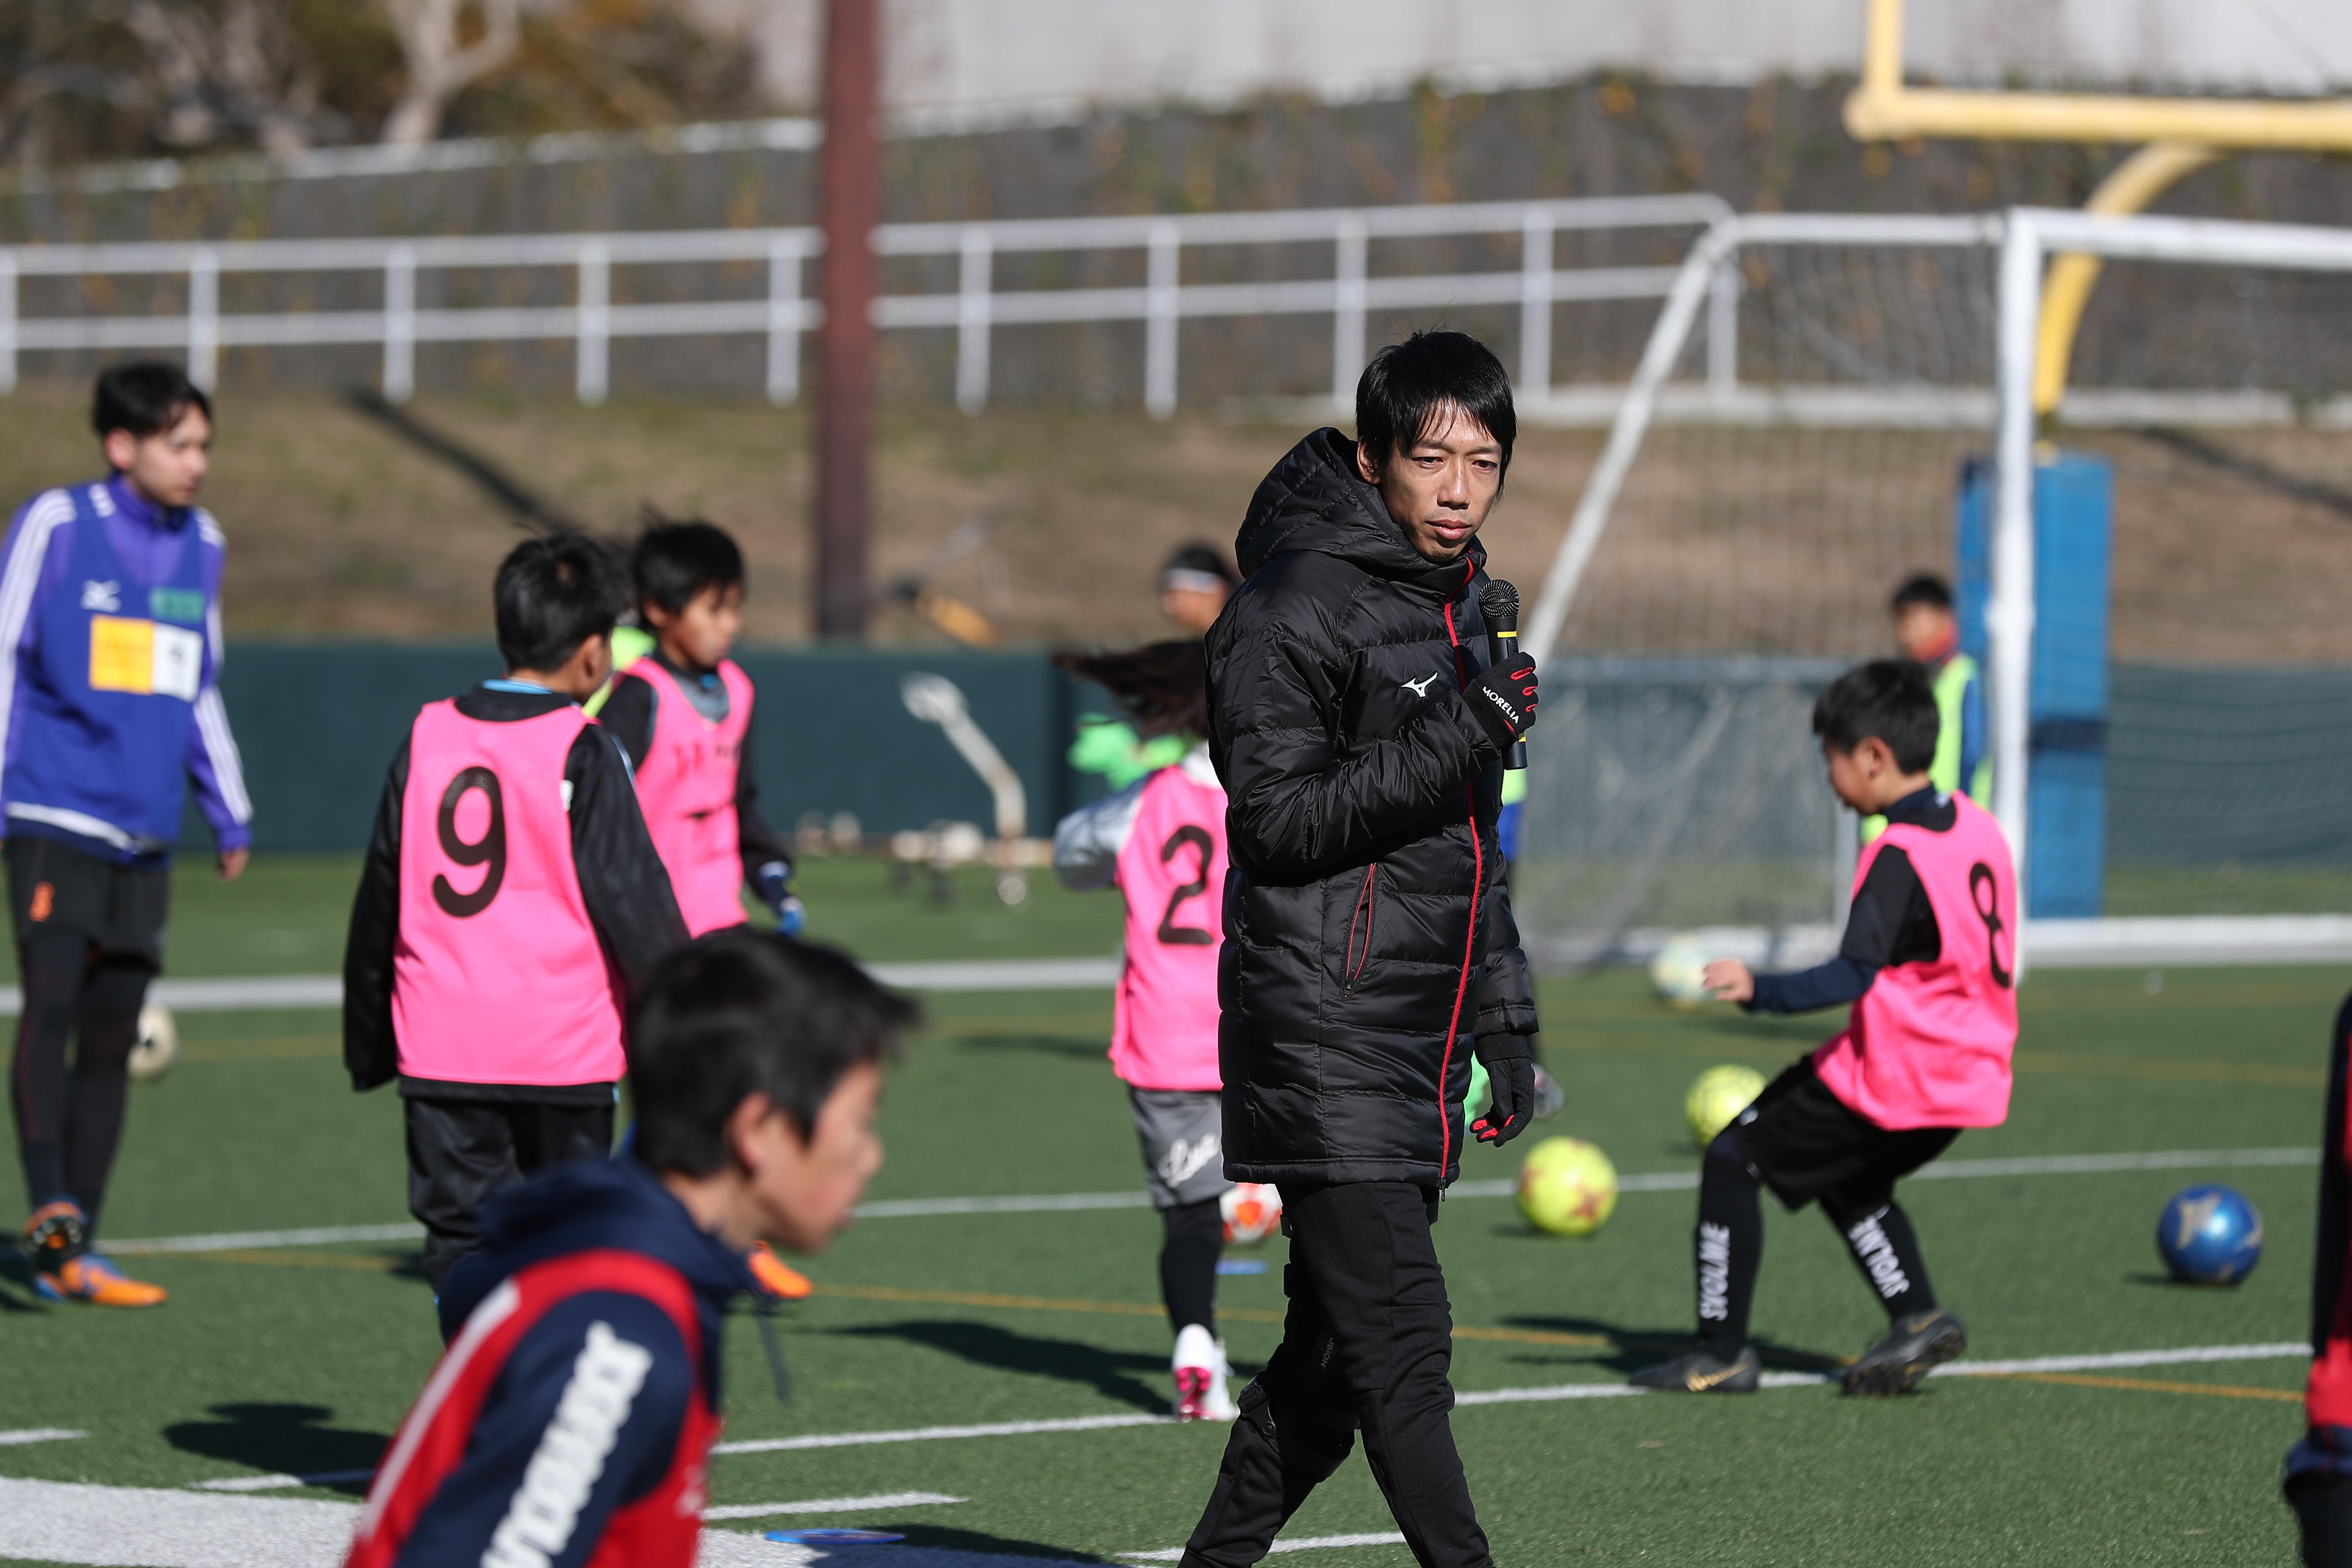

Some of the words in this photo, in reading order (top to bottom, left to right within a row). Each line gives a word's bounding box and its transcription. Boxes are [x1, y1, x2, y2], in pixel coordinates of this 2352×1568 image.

[1482, 686, 1519, 724] MORELIA
[432, 766, 507, 918] 9
[1157, 824, 1214, 945] 2
[1969, 862, 2011, 989] 8
